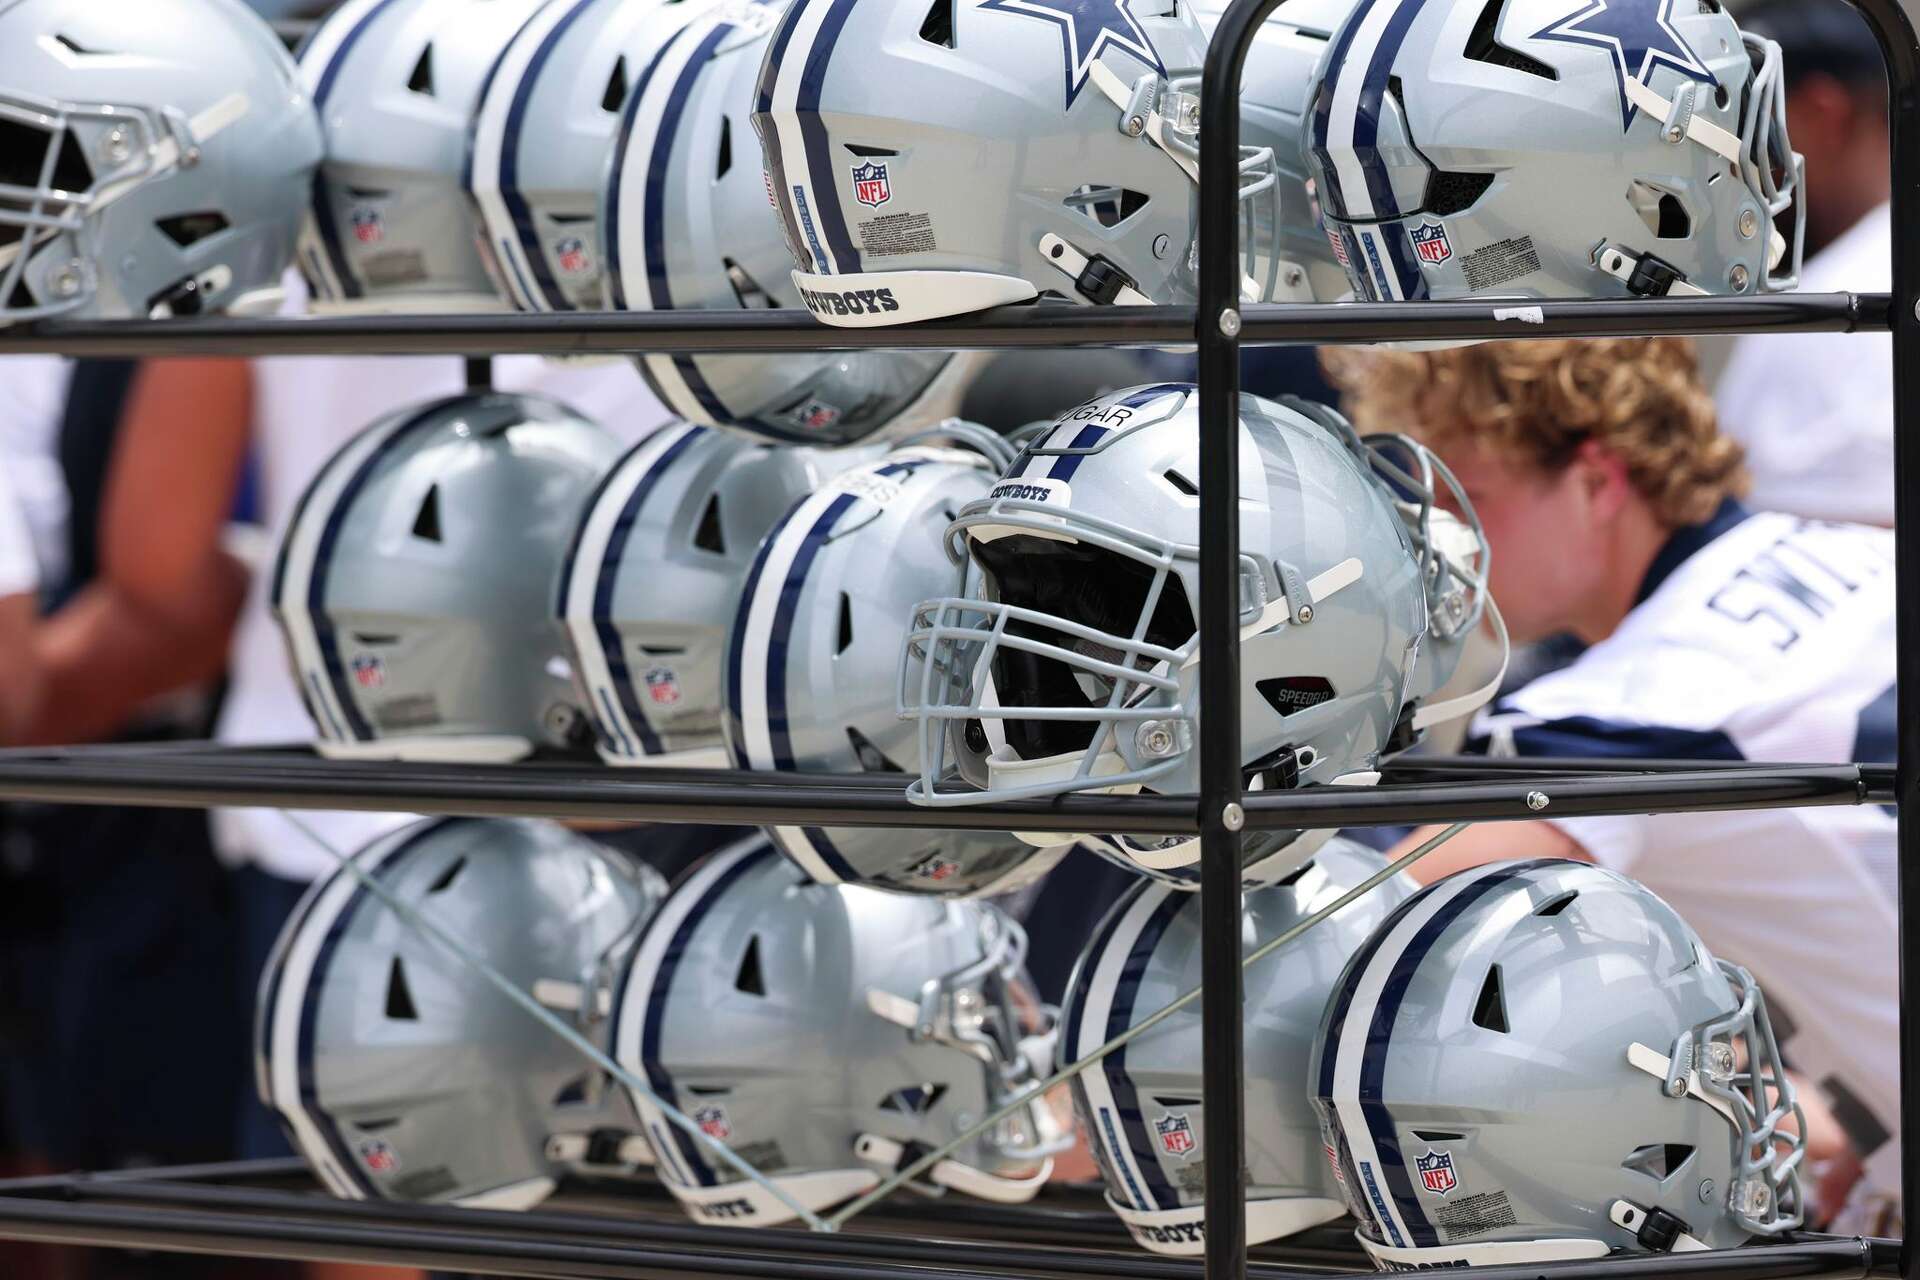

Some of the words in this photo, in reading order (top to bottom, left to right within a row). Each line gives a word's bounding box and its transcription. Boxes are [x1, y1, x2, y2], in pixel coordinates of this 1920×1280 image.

[858, 181, 887, 202] NFL
[795, 188, 819, 249] JOHNSON
[1418, 240, 1449, 261] NFL
[800, 287, 899, 315] OWBOYS
[990, 484, 1052, 501] COWBOYS
[1163, 1132, 1193, 1152] NFL
[1423, 1169, 1454, 1189] NFL
